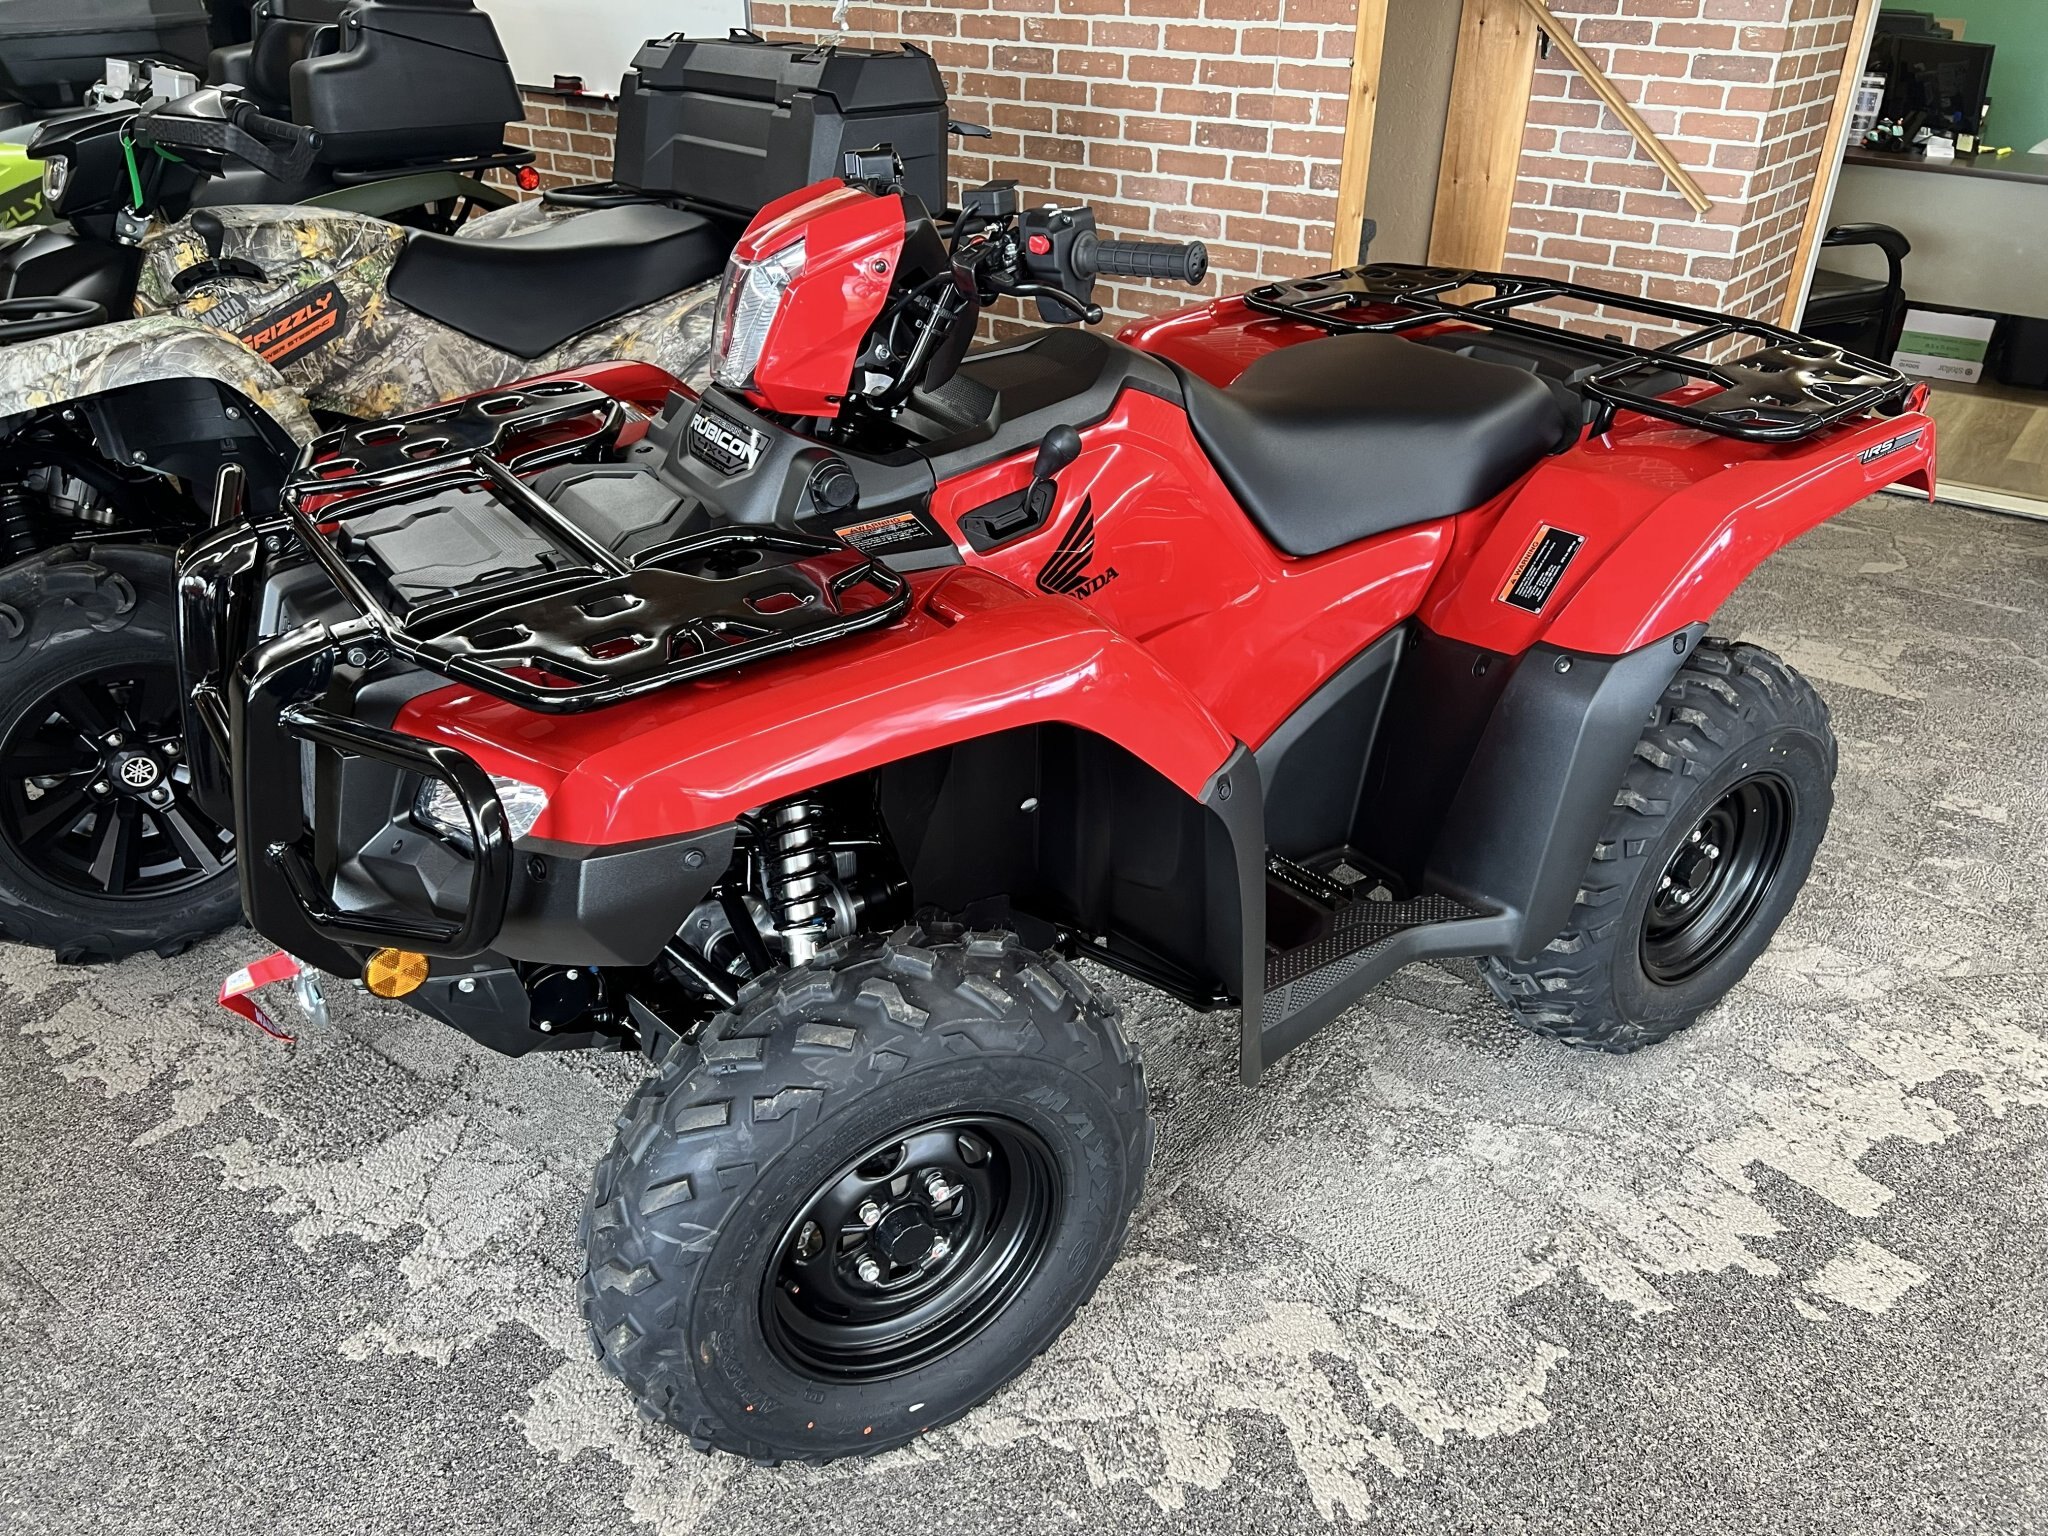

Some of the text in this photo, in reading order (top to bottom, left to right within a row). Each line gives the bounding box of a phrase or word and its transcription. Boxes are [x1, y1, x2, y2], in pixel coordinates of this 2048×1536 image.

[690, 413, 760, 470] RUBICON
[1863, 438, 1895, 460] IRS
[856, 517, 902, 533] WARNING
[1514, 540, 1539, 577] WARNING
